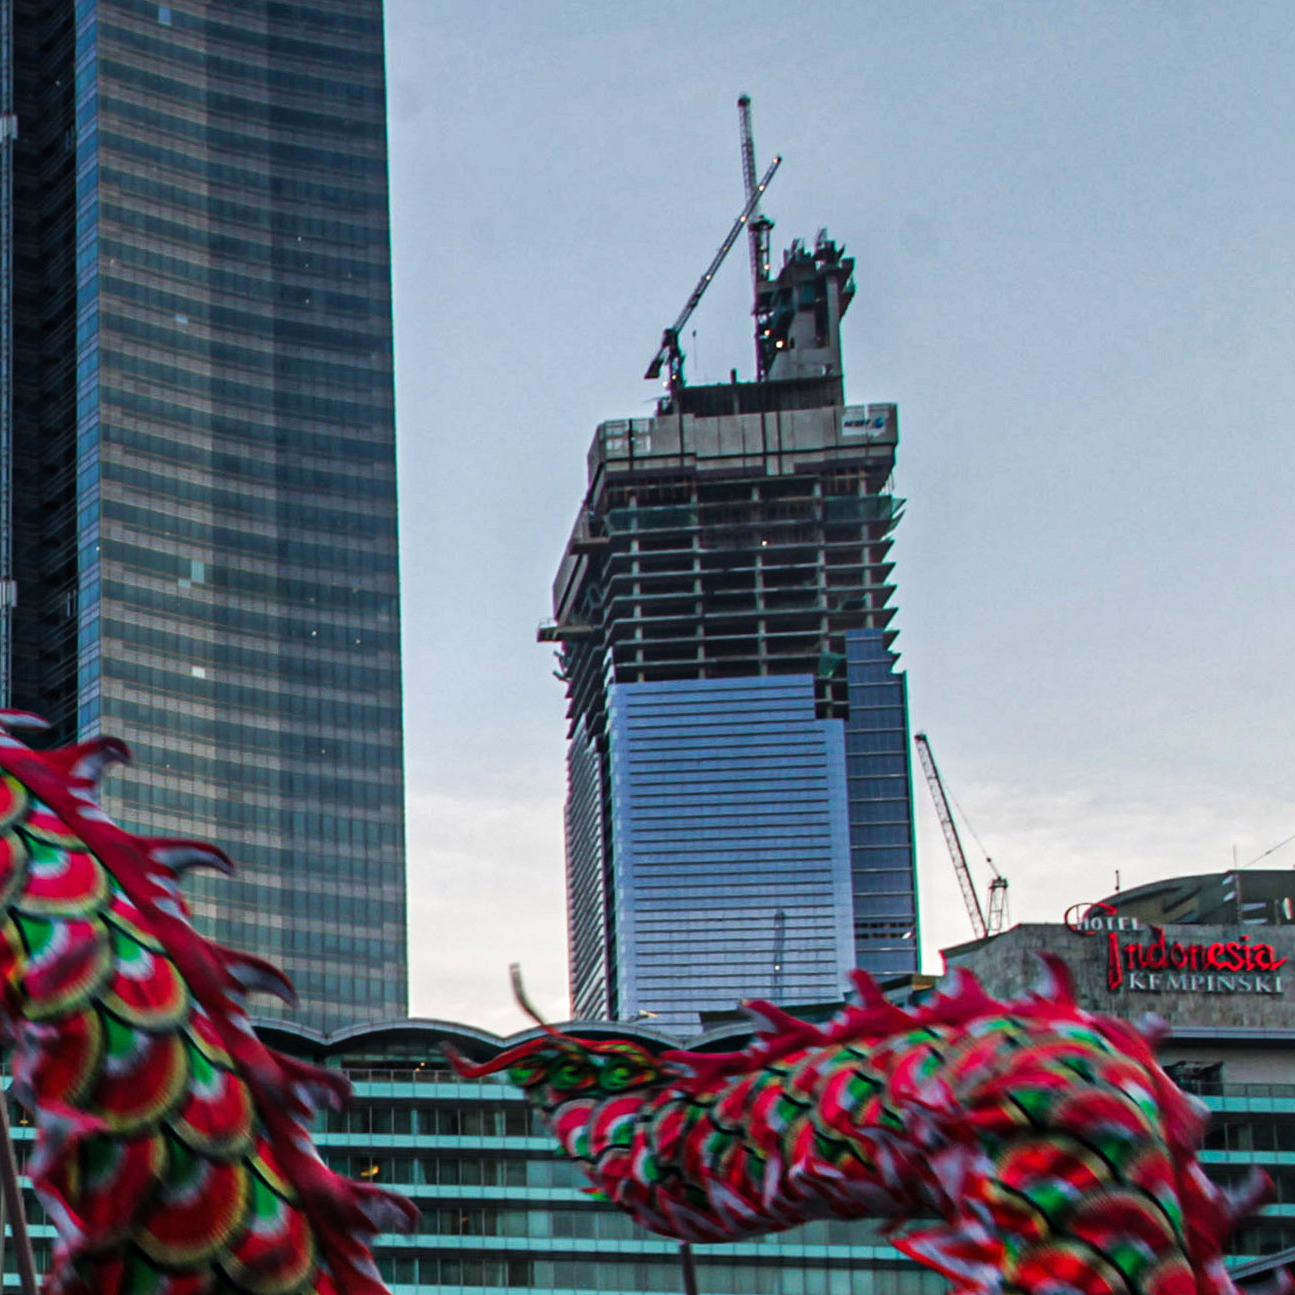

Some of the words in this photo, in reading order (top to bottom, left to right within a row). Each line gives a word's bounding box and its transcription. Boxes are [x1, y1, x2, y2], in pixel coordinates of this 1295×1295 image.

[1077, 916, 1143, 932] HOTEL
[1104, 922, 1288, 991] Indonesia
[1129, 973, 1284, 993] KEMPINSKI
